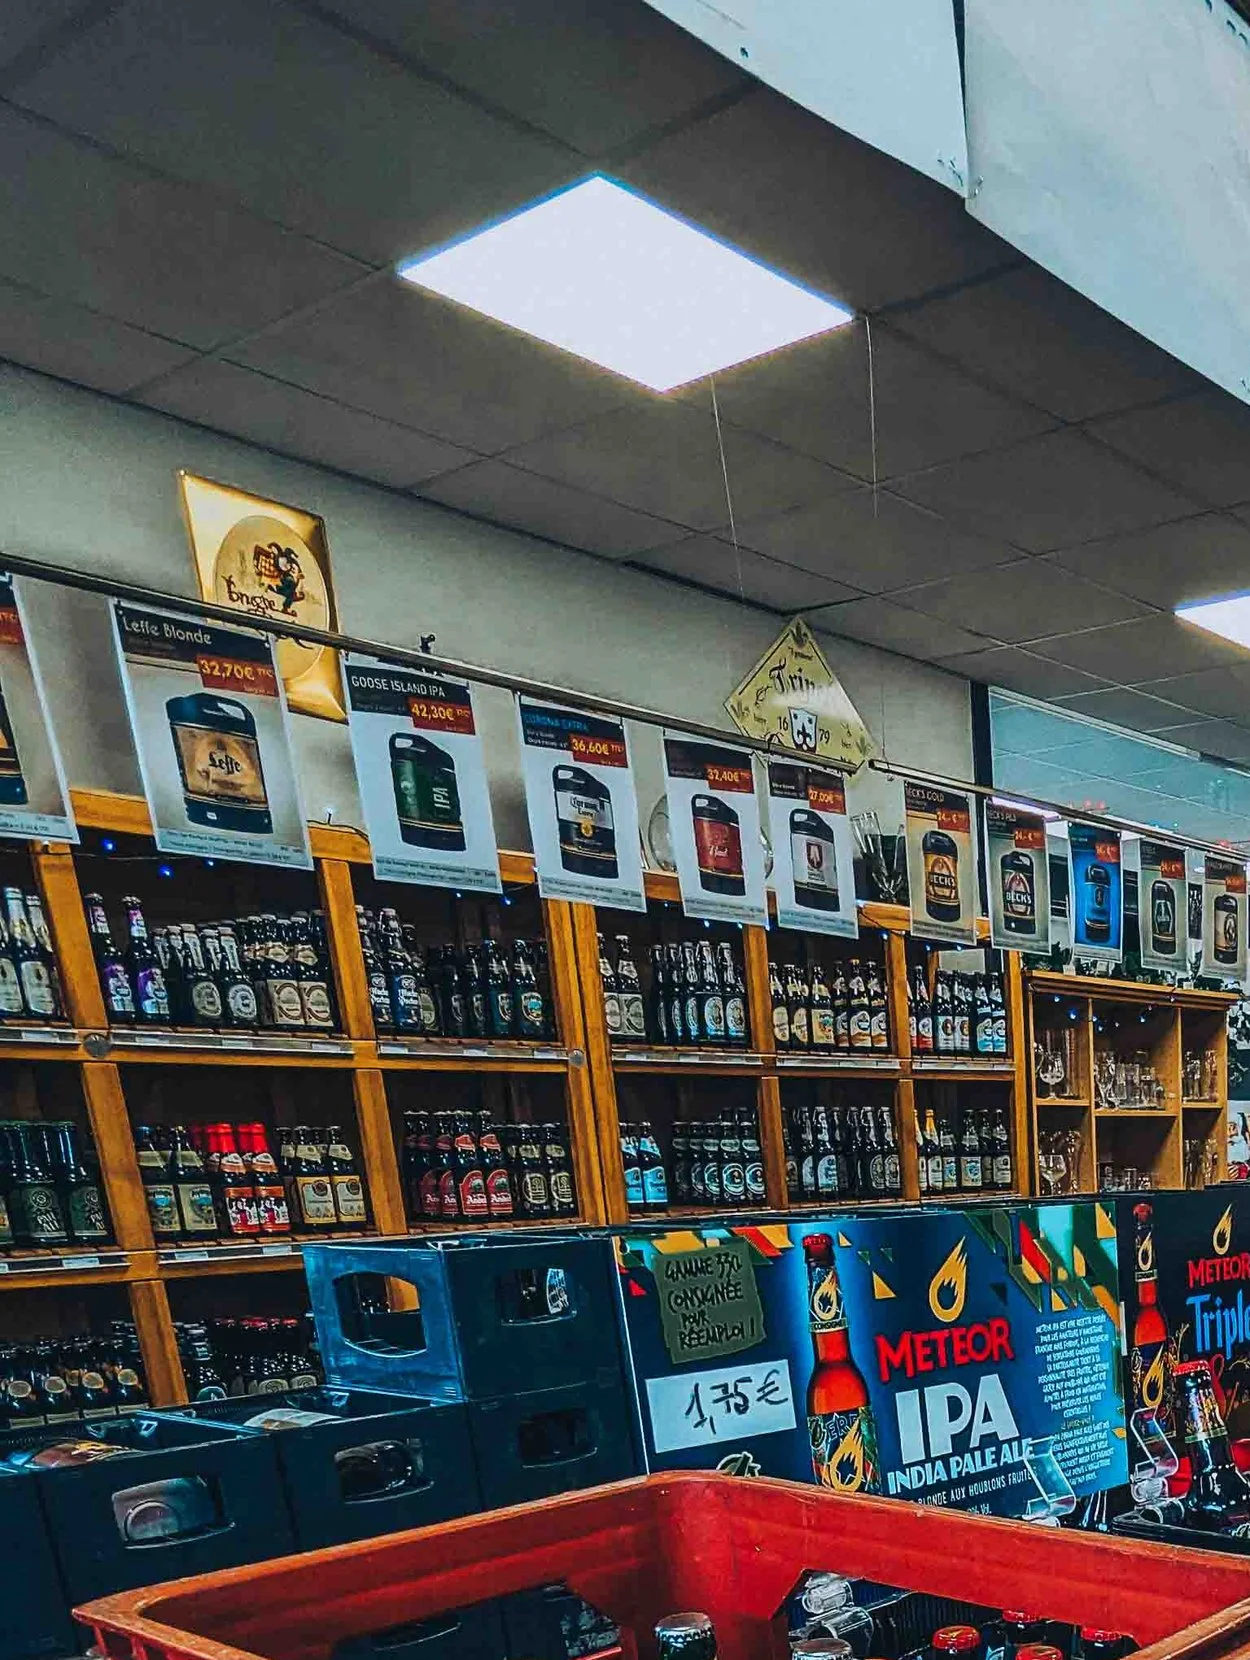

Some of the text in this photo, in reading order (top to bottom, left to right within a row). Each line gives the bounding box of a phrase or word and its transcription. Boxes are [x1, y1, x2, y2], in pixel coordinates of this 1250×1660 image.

[123, 618, 212, 645] Leffe Blonde
[201, 659, 254, 681] 32,70€
[351, 675, 446, 698] GOOSE ISLAND IPA
[411, 702, 455, 721] 42,30€
[778, 715, 789, 731] 16
[572, 739, 609, 756] 36,60€
[818, 728, 831, 745] 79
[707, 768, 740, 782] 32,40€
[433, 786, 450, 811] IPA
[682, 1310, 709, 1328] POUR
[874, 1317, 1015, 1383] METEOR
[895, 1374, 1021, 1466] IPA
[887, 1438, 1035, 1495] INDIA PALE ALE
[918, 1491, 947, 1506] BLONDE
[950, 1486, 966, 1500] AUX
[969, 1477, 1006, 1496] HOUBLONS
